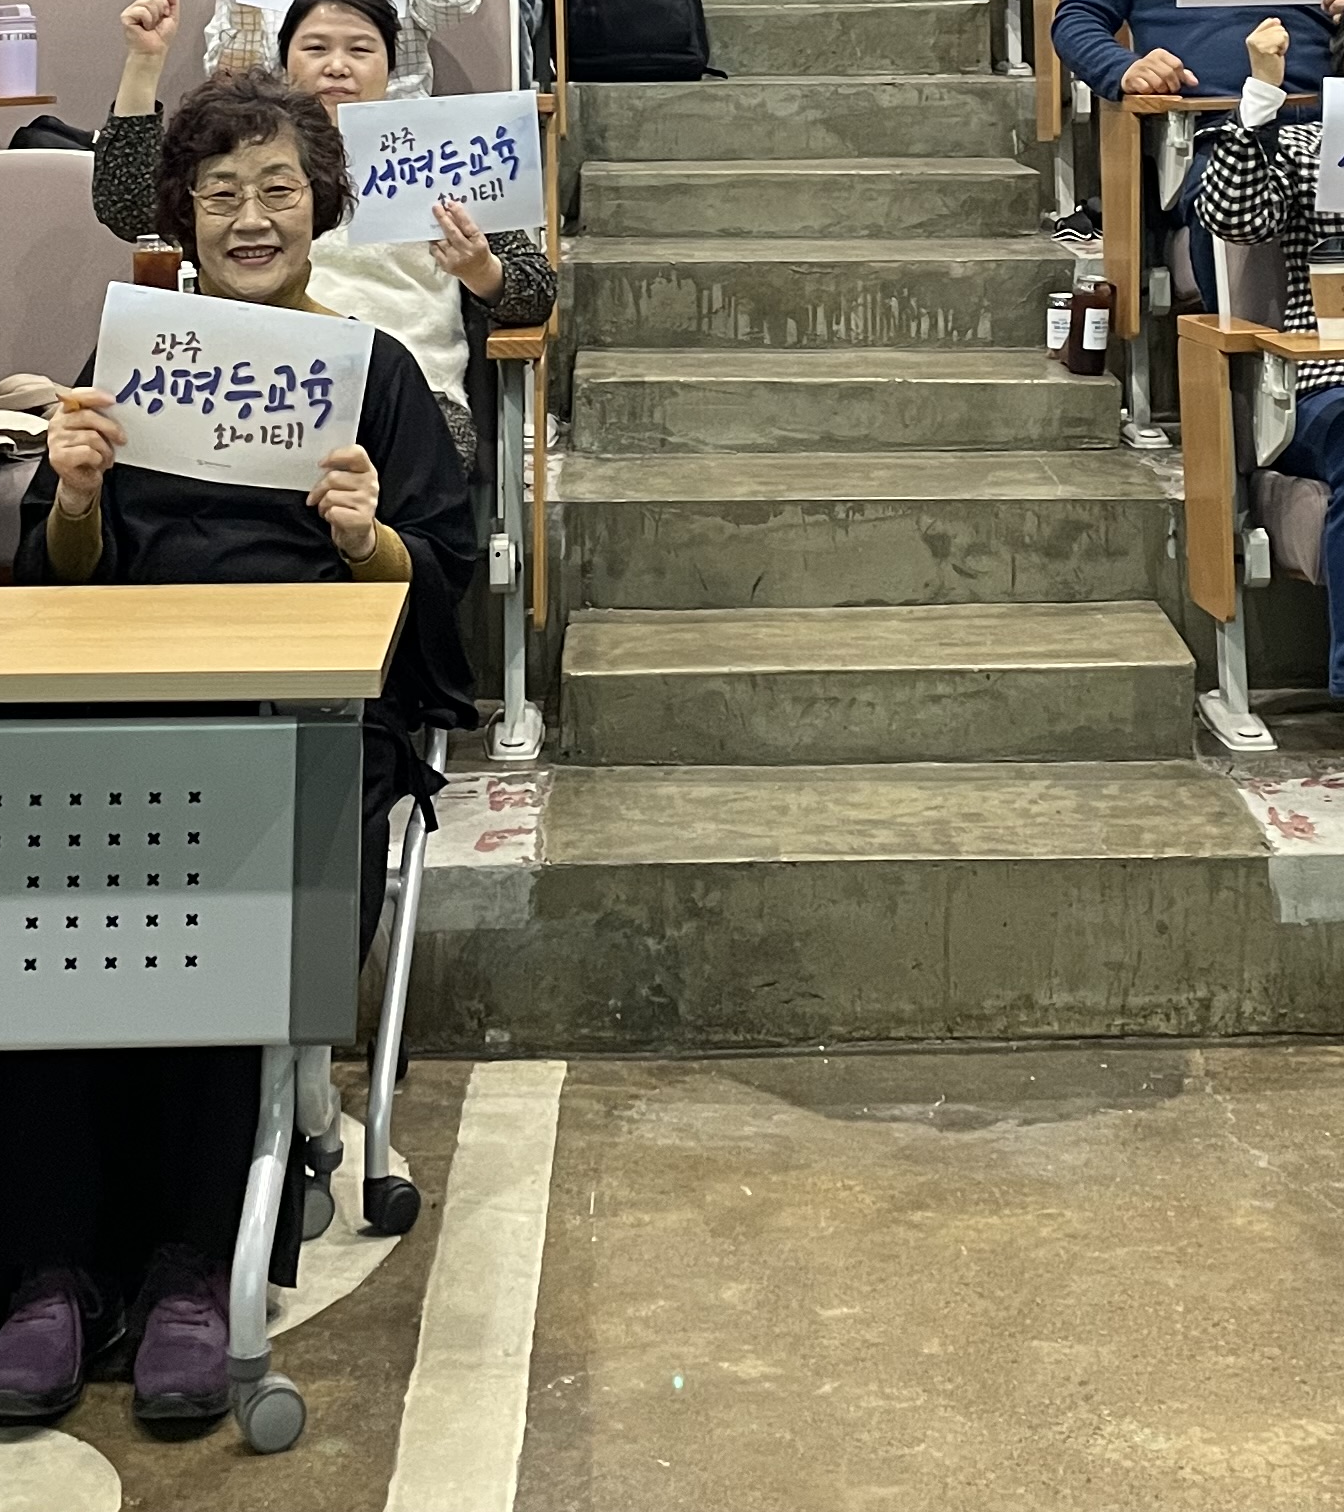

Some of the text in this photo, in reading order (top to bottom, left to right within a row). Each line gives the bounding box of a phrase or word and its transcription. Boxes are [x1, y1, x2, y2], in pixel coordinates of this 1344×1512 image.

[362, 126, 519, 198] 성평등교육
[380, 128, 416, 152] 광주
[151, 331, 202, 363] 광주
[115, 359, 333, 429] 성평등교육
